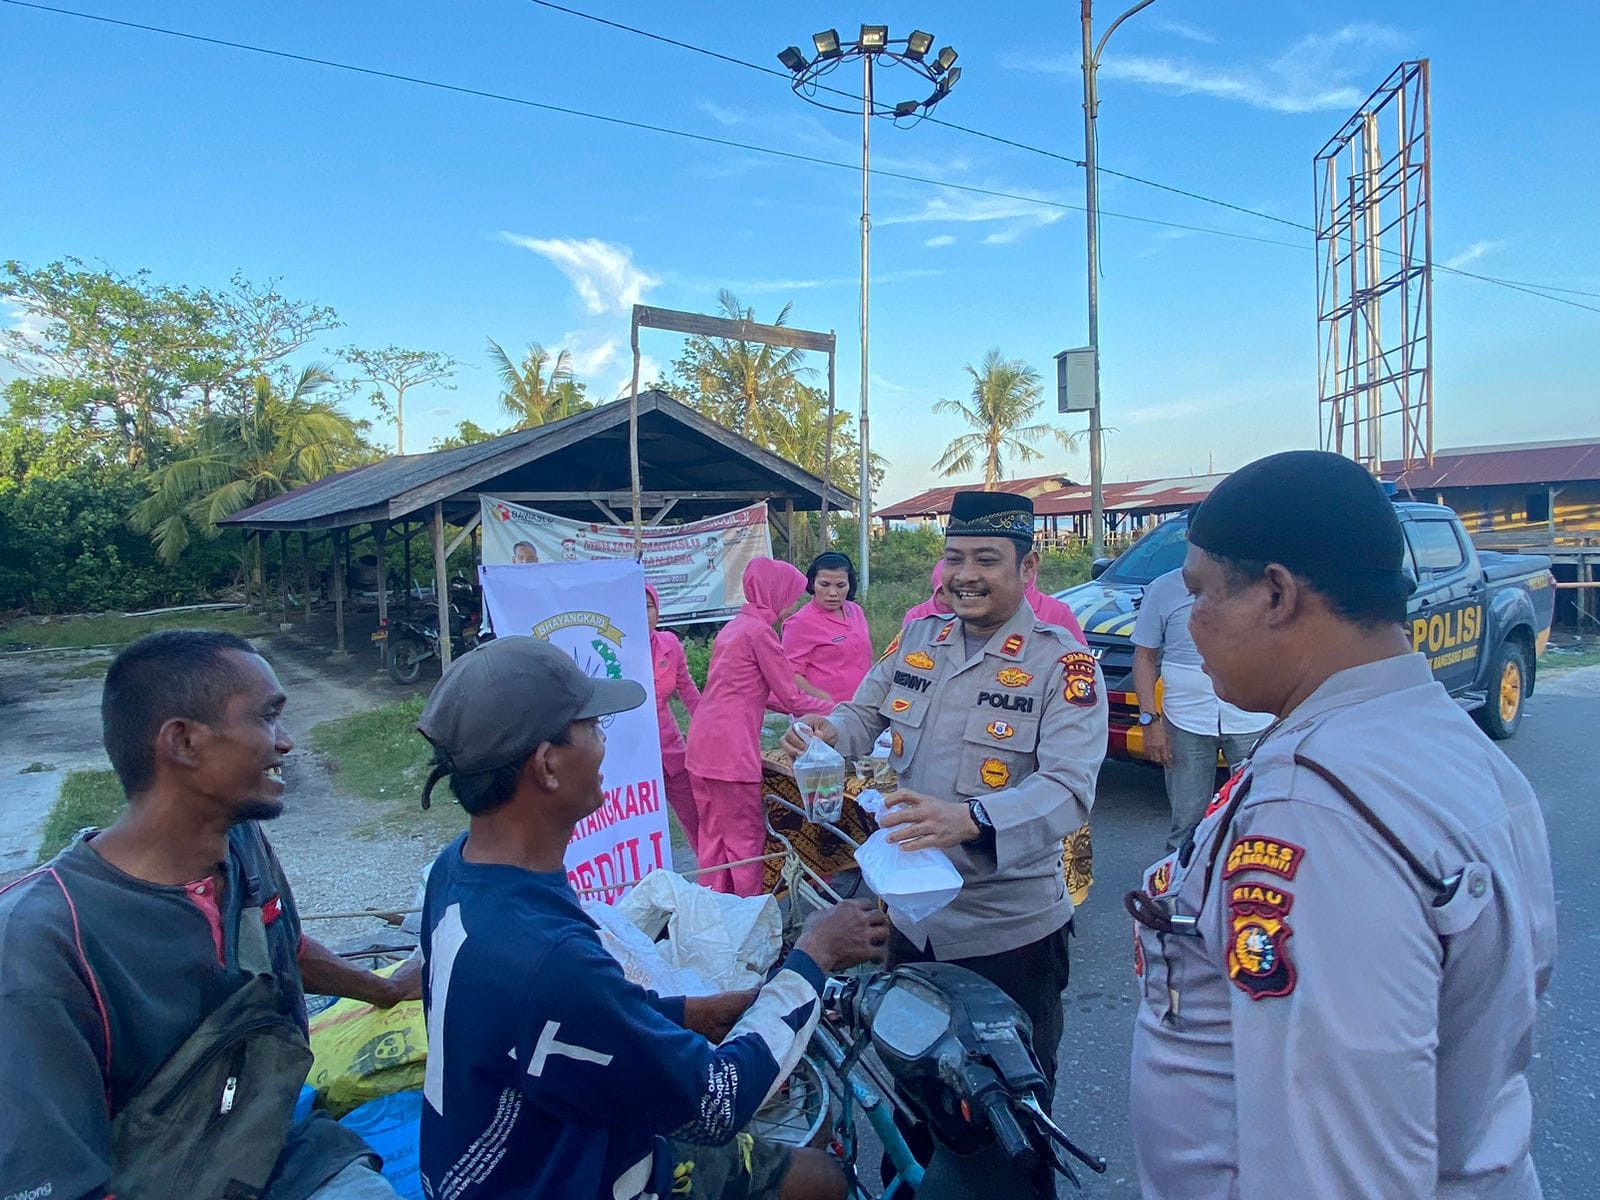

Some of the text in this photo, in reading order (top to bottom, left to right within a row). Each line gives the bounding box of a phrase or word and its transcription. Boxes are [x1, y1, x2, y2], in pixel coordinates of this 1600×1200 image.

[537, 613, 605, 635] BHAYANGKARI
[1413, 605, 1482, 653] POLISI
[893, 670, 932, 693] BENNY
[977, 691, 1032, 713] POLRI
[1232, 887, 1283, 905] RIAU
